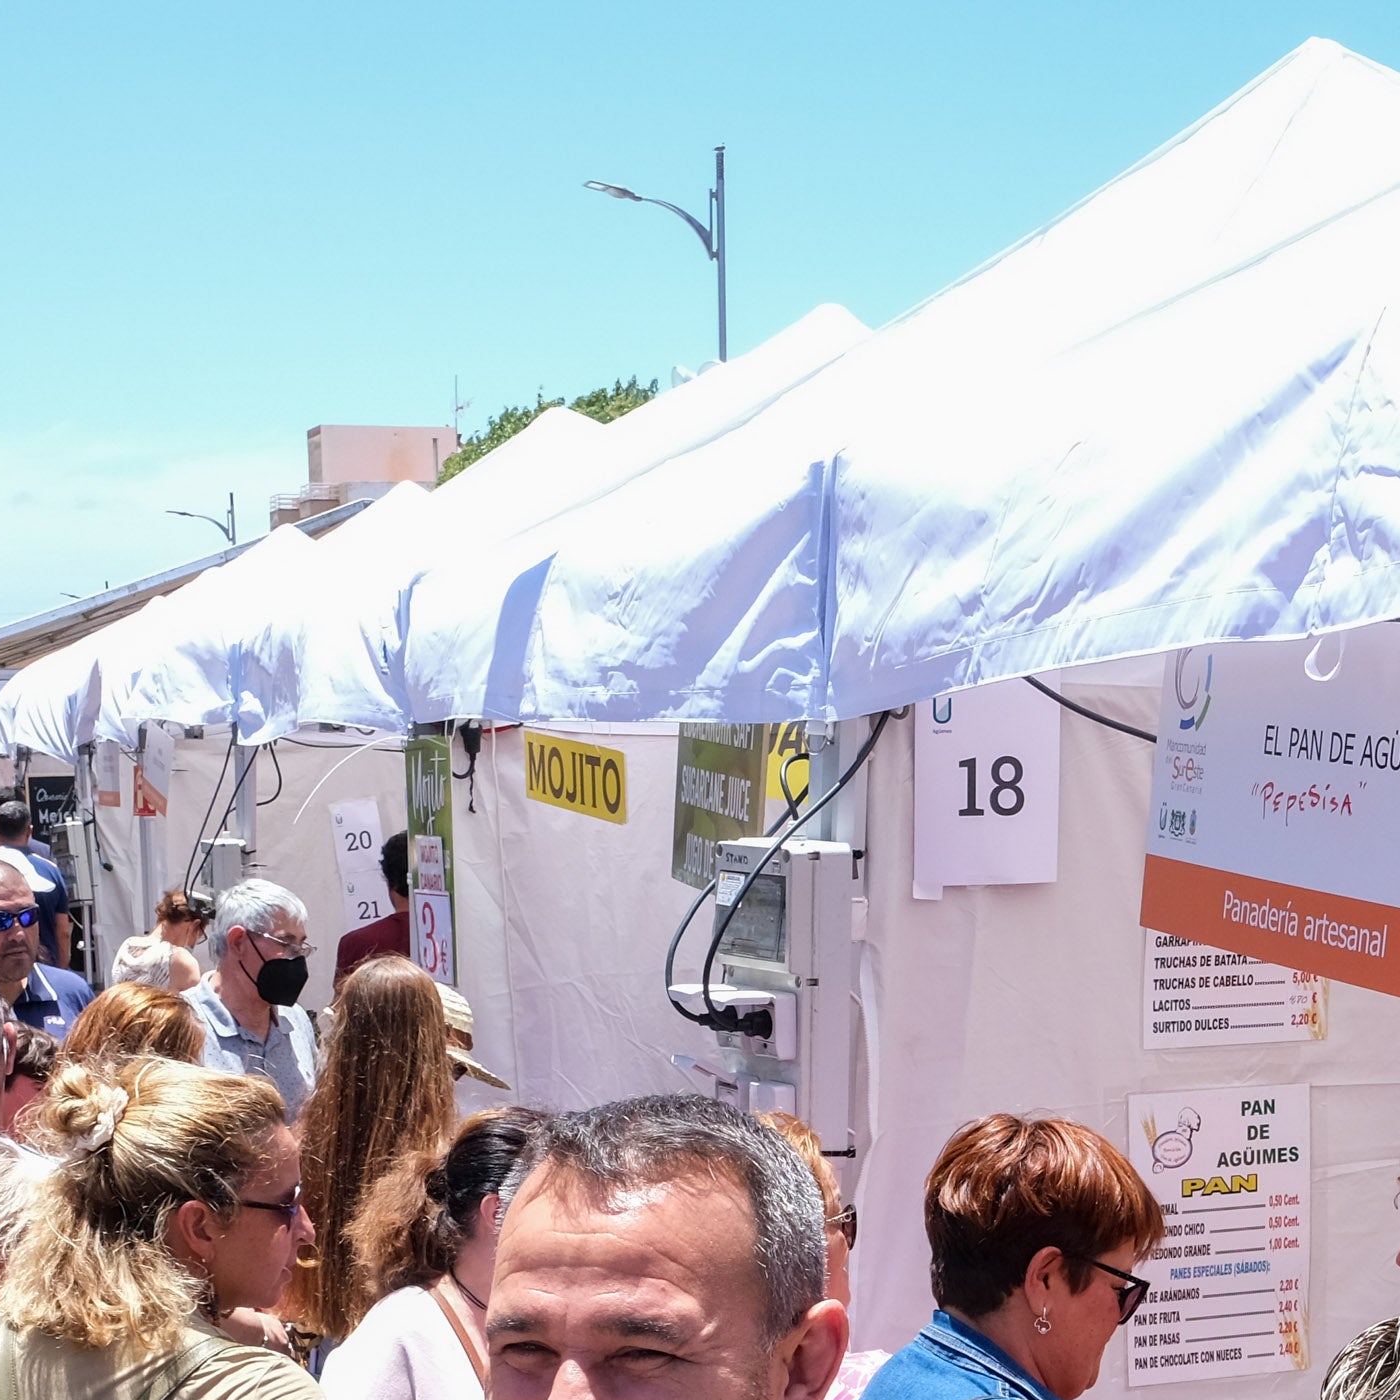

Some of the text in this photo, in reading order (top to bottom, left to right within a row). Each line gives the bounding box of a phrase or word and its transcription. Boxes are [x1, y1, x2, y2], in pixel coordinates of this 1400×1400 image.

[1263, 724, 1282, 757] EL
[1288, 727, 1323, 761] PAN
[1329, 731, 1356, 765] DE
[528, 741, 621, 814] MOJITO
[958, 755, 1025, 817] 18
[681, 765, 751, 823] SUGARCANE JUICE
[344, 830, 372, 852] 20
[725, 852, 749, 865] STAND
[357, 900, 382, 920] 21
[1223, 890, 1388, 958] Panadería artesanal
[422, 901, 439, 974] 3
[1154, 954, 1248, 969] TRUCHAS DE BATATA
[1153, 977, 1196, 991] TRUCHAS
[1199, 977, 1211, 988] DE
[1213, 974, 1253, 988] CABELLO
[1292, 971, 1311, 985] 5,00
[1153, 999, 1191, 1012] LACITOS
[1153, 1020, 1192, 1034] SURTIDO
[1194, 1018, 1229, 1031] DULCES
[1291, 1013, 1309, 1028] 2,20
[1241, 1099, 1275, 1117] PAN
[1247, 1124, 1270, 1141] DE
[1217, 1146, 1299, 1168] AGÜIMES
[1181, 1174, 1258, 1198] PAN
[1269, 1195, 1282, 1210] 0,50
[1283, 1194, 1300, 1207] Cent.
[1184, 1223, 1205, 1236] CHICO
[1268, 1217, 1282, 1231] 0,50
[1283, 1215, 1300, 1228] Cent.
[1184, 1244, 1211, 1257] GRANDE
[1269, 1238, 1282, 1252] 1,00
[1283, 1237, 1300, 1250] Cent.
[1170, 1267, 1192, 1280] PANES
[1193, 1263, 1233, 1278] ESPECIALES
[1149, 1291, 1158, 1304] DE
[1160, 1286, 1200, 1303] ARÁNDANOS
[1279, 1279, 1293, 1294] 2,20
[1134, 1314, 1147, 1326] PAN
[1149, 1313, 1158, 1325] DE
[1159, 1311, 1180, 1323] FRUTA
[1278, 1301, 1292, 1315] 2,40
[1134, 1336, 1148, 1349] PAN
[1149, 1335, 1158, 1347] DE
[1159, 1332, 1180, 1345] PASAS
[1278, 1321, 1292, 1336] 2,20
[1134, 1357, 1148, 1370] PAN
[1150, 1356, 1158, 1369] DE
[1160, 1352, 1199, 1368] CHOCOLATE
[1200, 1350, 1215, 1363] CON
[1216, 1348, 1242, 1361] NUECES
[1279, 1343, 1293, 1357] 2,40
